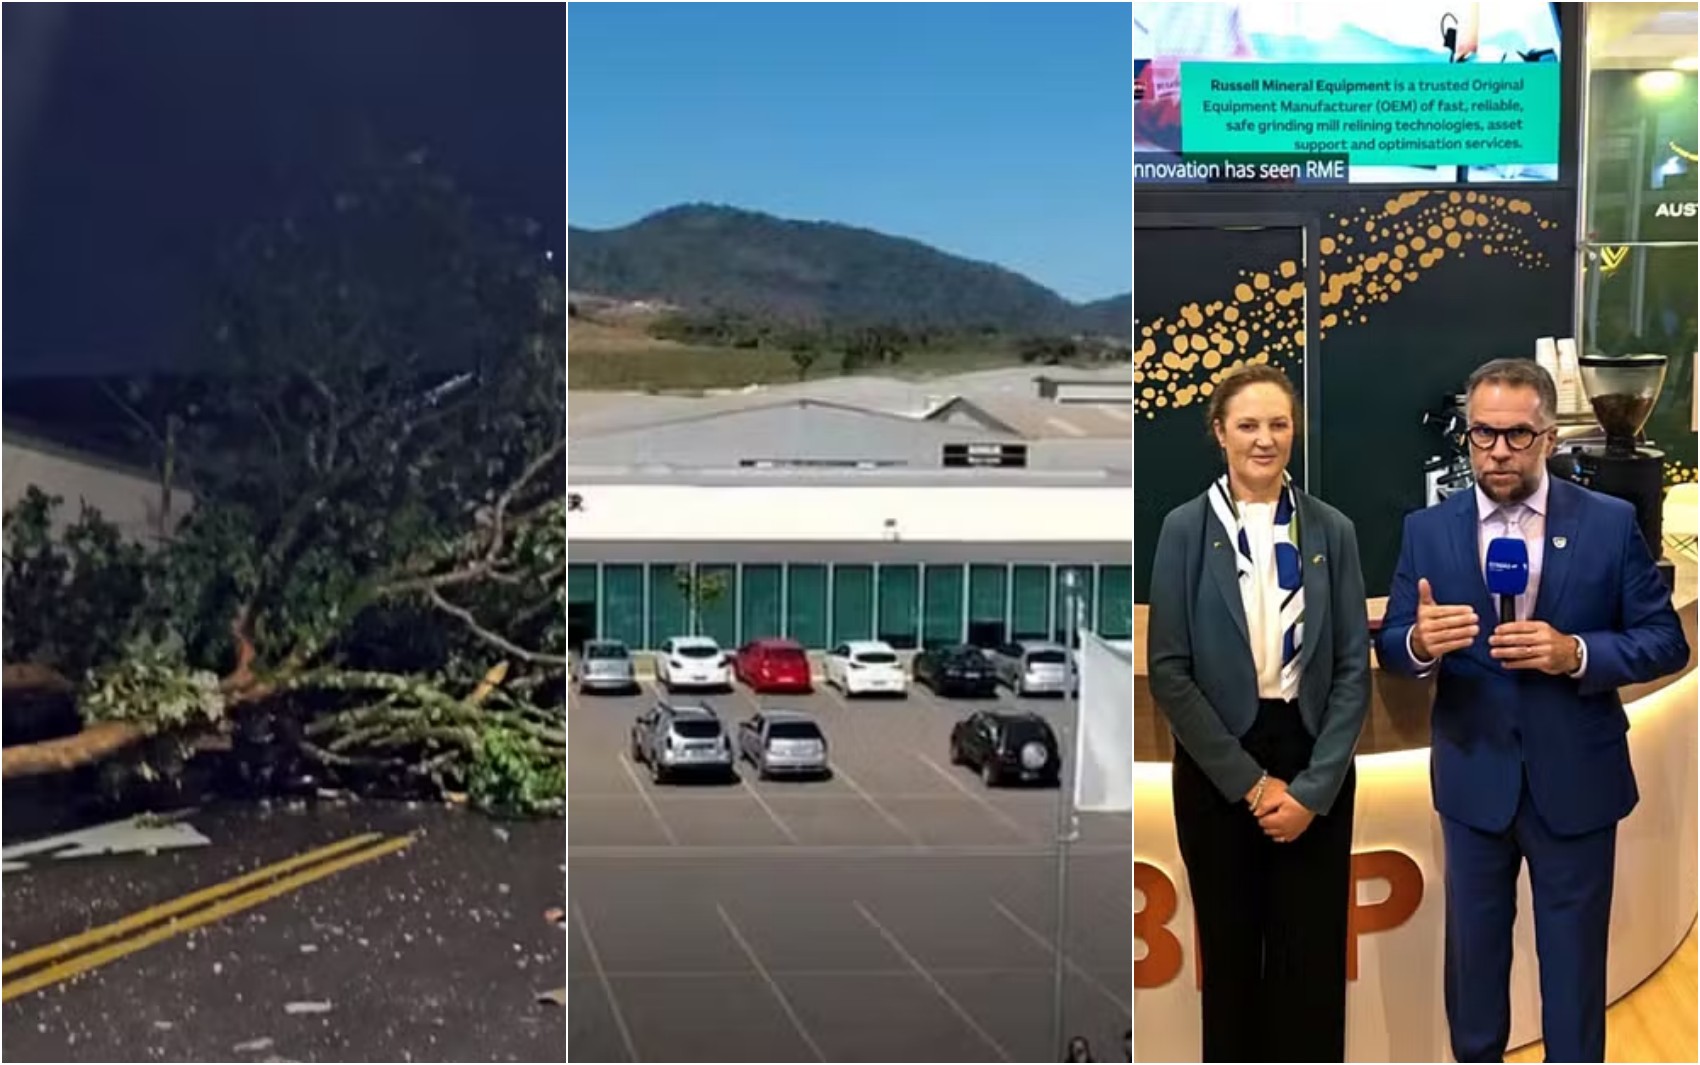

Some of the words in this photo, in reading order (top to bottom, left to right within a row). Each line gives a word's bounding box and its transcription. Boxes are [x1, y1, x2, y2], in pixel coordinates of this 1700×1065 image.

[1210, 79, 1260, 92] Russell
[1262, 79, 1313, 92] Mineral
[1316, 79, 1391, 95] Equipment
[1394, 79, 1405, 92] is
[1407, 81, 1416, 92] a
[1418, 79, 1469, 92] trusted
[1472, 77, 1524, 94] Original
[1203, 100, 1277, 114] Equipment
[1280, 99, 1372, 113] Manufacturer
[1375, 99, 1418, 114] (OEM)
[1420, 99, 1435, 113] of
[1437, 99, 1469, 113] fast,
[1471, 98, 1524, 113] reliable,
[1226, 118, 1255, 131] safe
[1258, 119, 1313, 134] grinding
[1316, 119, 1340, 131] mill
[1343, 119, 1392, 134] relining
[1395, 118, 1485, 134] technologies,
[1487, 119, 1523, 131] asset
[1294, 139, 1348, 153] support
[1350, 138, 1375, 150] and
[1378, 137, 1462, 152] optimisation
[1465, 136, 1523, 150] services.
[1134, 161, 1220, 179] nnovation
[1224, 159, 1256, 179] has
[1260, 164, 1301, 179] seen
[1305, 161, 1345, 179] RME
[1655, 202, 1698, 217] AUS
[1134, 849, 1424, 992] BP
